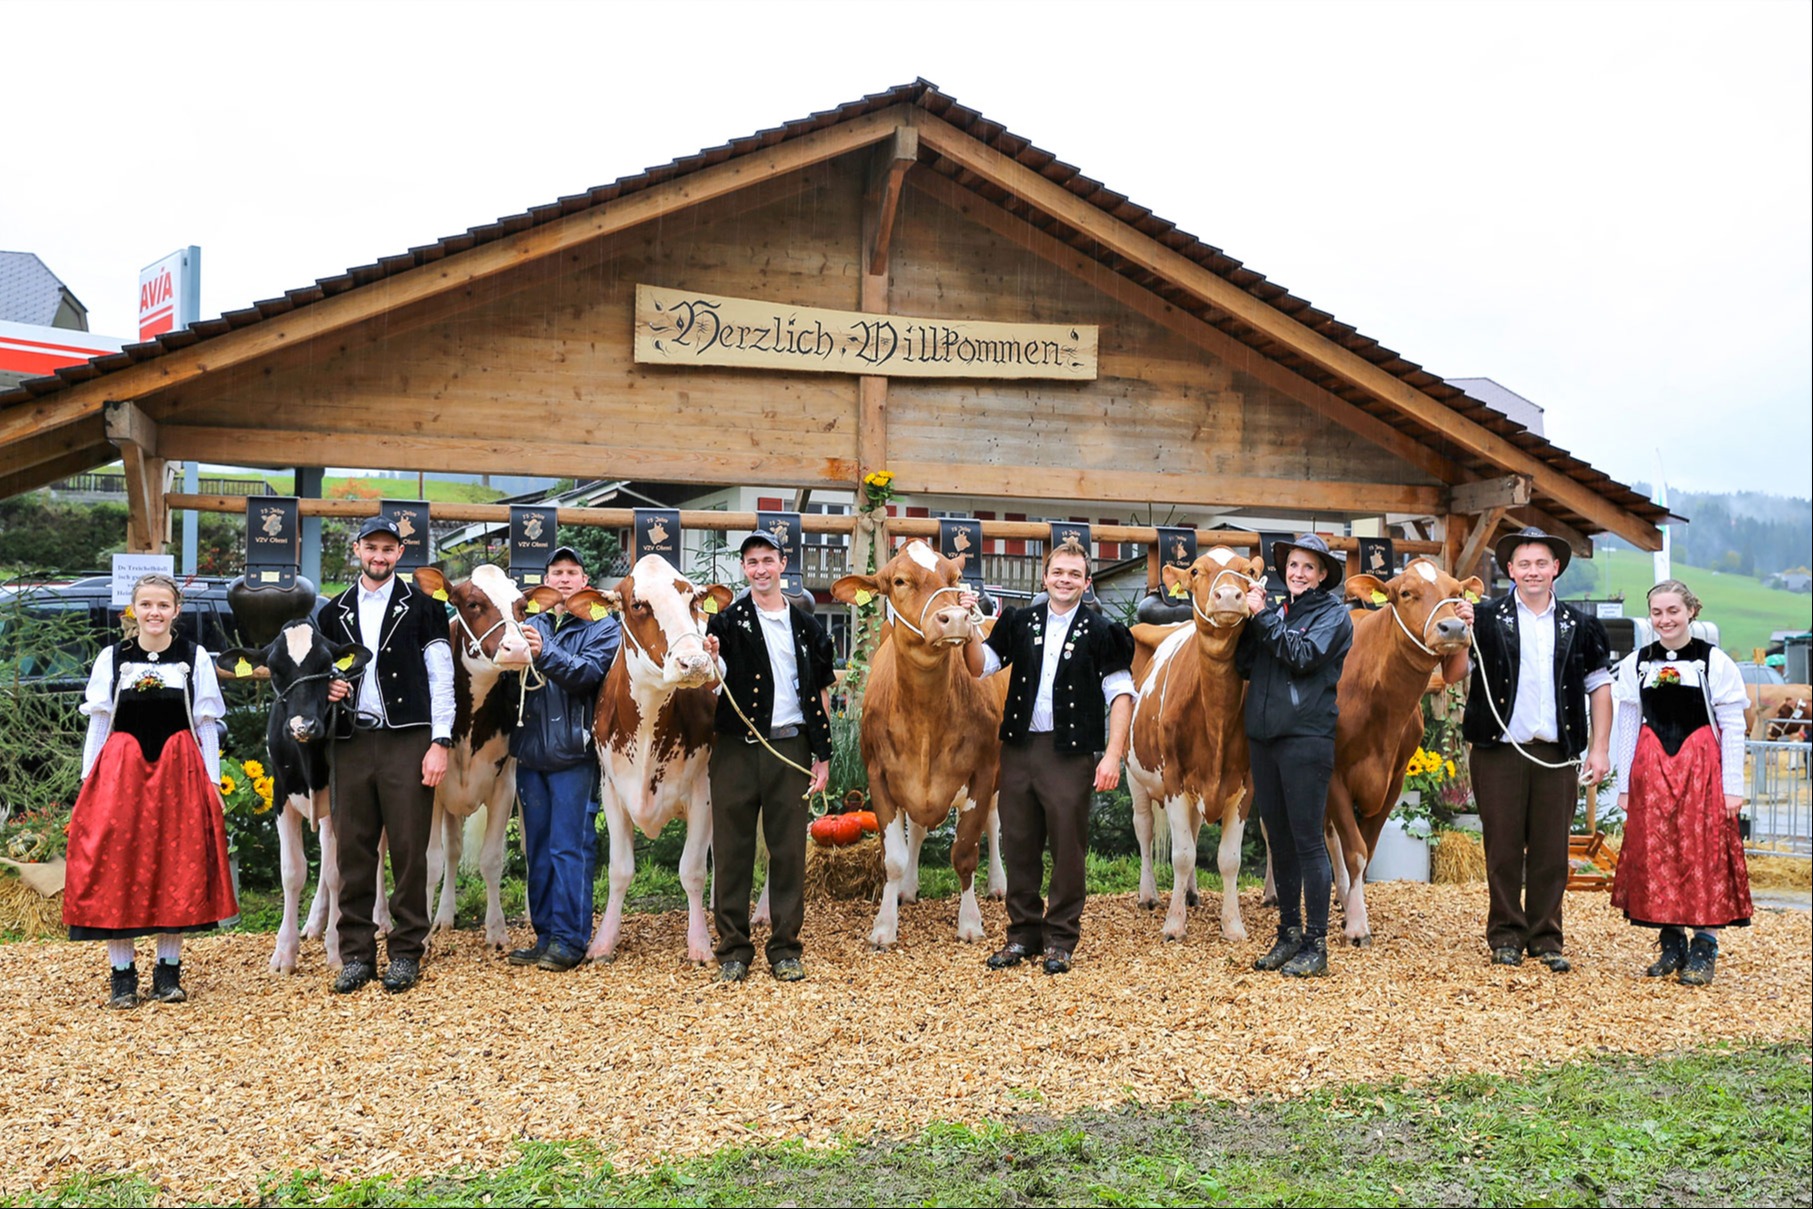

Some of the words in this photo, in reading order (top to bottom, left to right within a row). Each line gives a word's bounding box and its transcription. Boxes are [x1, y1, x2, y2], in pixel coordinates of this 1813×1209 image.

[140, 266, 173, 314] AVIA
[669, 299, 835, 360] Herzlich
[850, 320, 1063, 367] Willkommen
